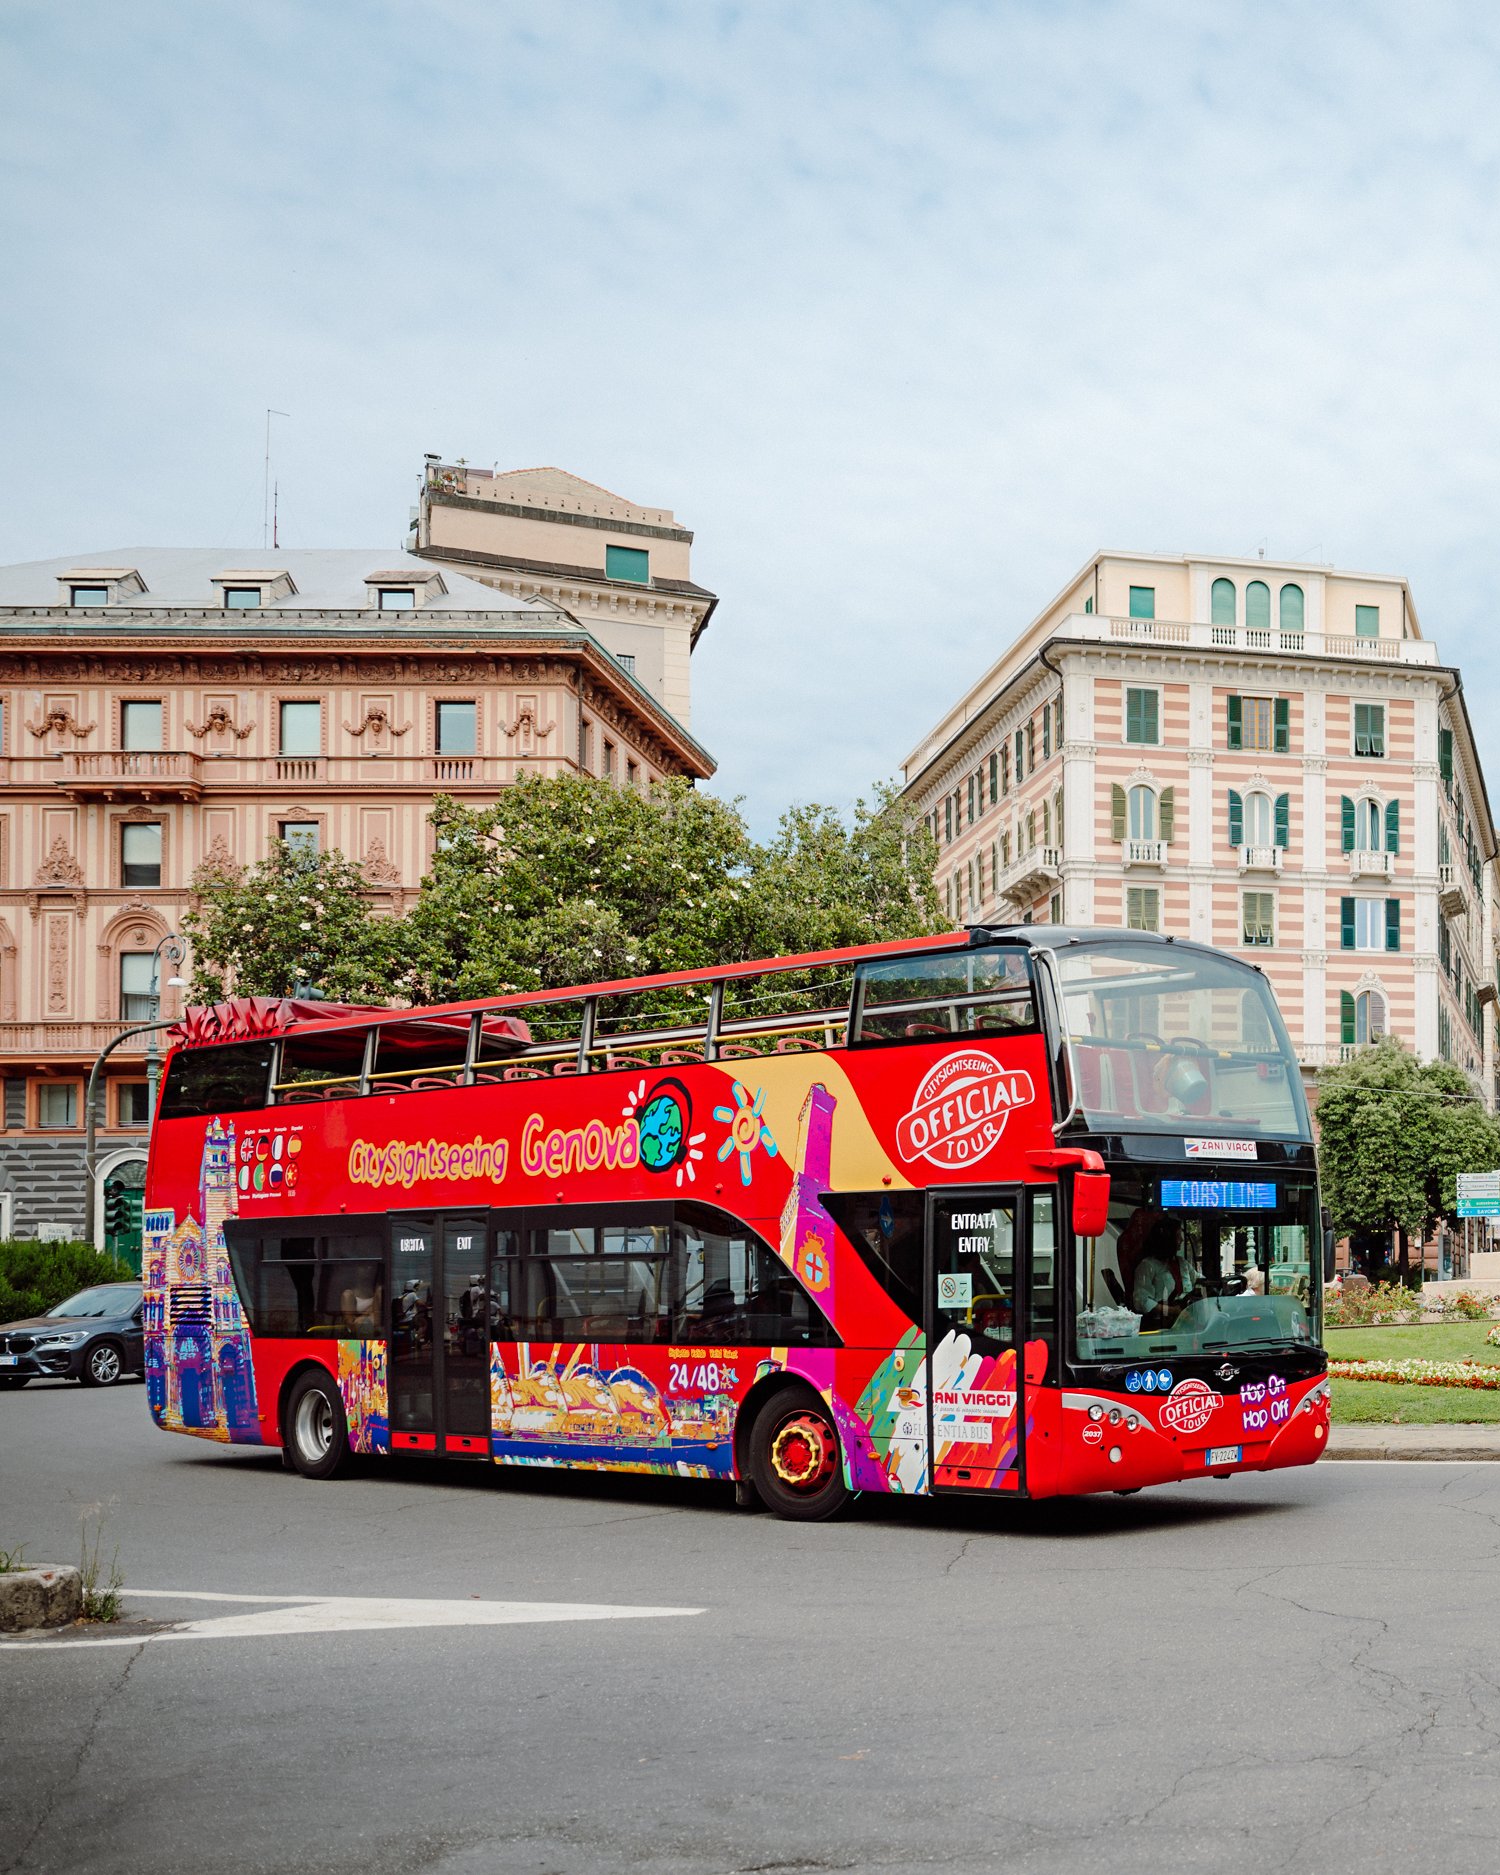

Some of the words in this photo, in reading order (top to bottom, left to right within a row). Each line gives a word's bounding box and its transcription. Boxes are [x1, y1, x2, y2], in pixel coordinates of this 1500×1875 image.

[924, 1059, 993, 1100] CITYSIGHTSEEING
[910, 1077, 1026, 1148] OFFICIAL
[946, 1122, 999, 1159] TOUR
[1201, 1141, 1224, 1150] ZANI
[1226, 1142, 1257, 1152] VIAGGI
[1180, 1181, 1263, 1208] COASTLINE
[951, 1213, 998, 1230] ENTRATA
[400, 1238, 424, 1252] USCITA
[456, 1236, 473, 1250] EXIT
[958, 1236, 990, 1253] ENTRY
[669, 1363, 720, 1392] 24/48
[933, 1391, 958, 1405] ANI
[961, 1393, 1011, 1407] VIAGGI
[1241, 1383, 1266, 1403] Hop
[1268, 1375, 1286, 1395] On
[1166, 1395, 1219, 1422] OFFICIAL
[1243, 1409, 1268, 1429] Hop
[1270, 1398, 1289, 1421] Off
[913, 1423, 968, 1439] FLENTIA
[970, 1427, 989, 1440] BUS
[1183, 1412, 1207, 1429] TOUR
